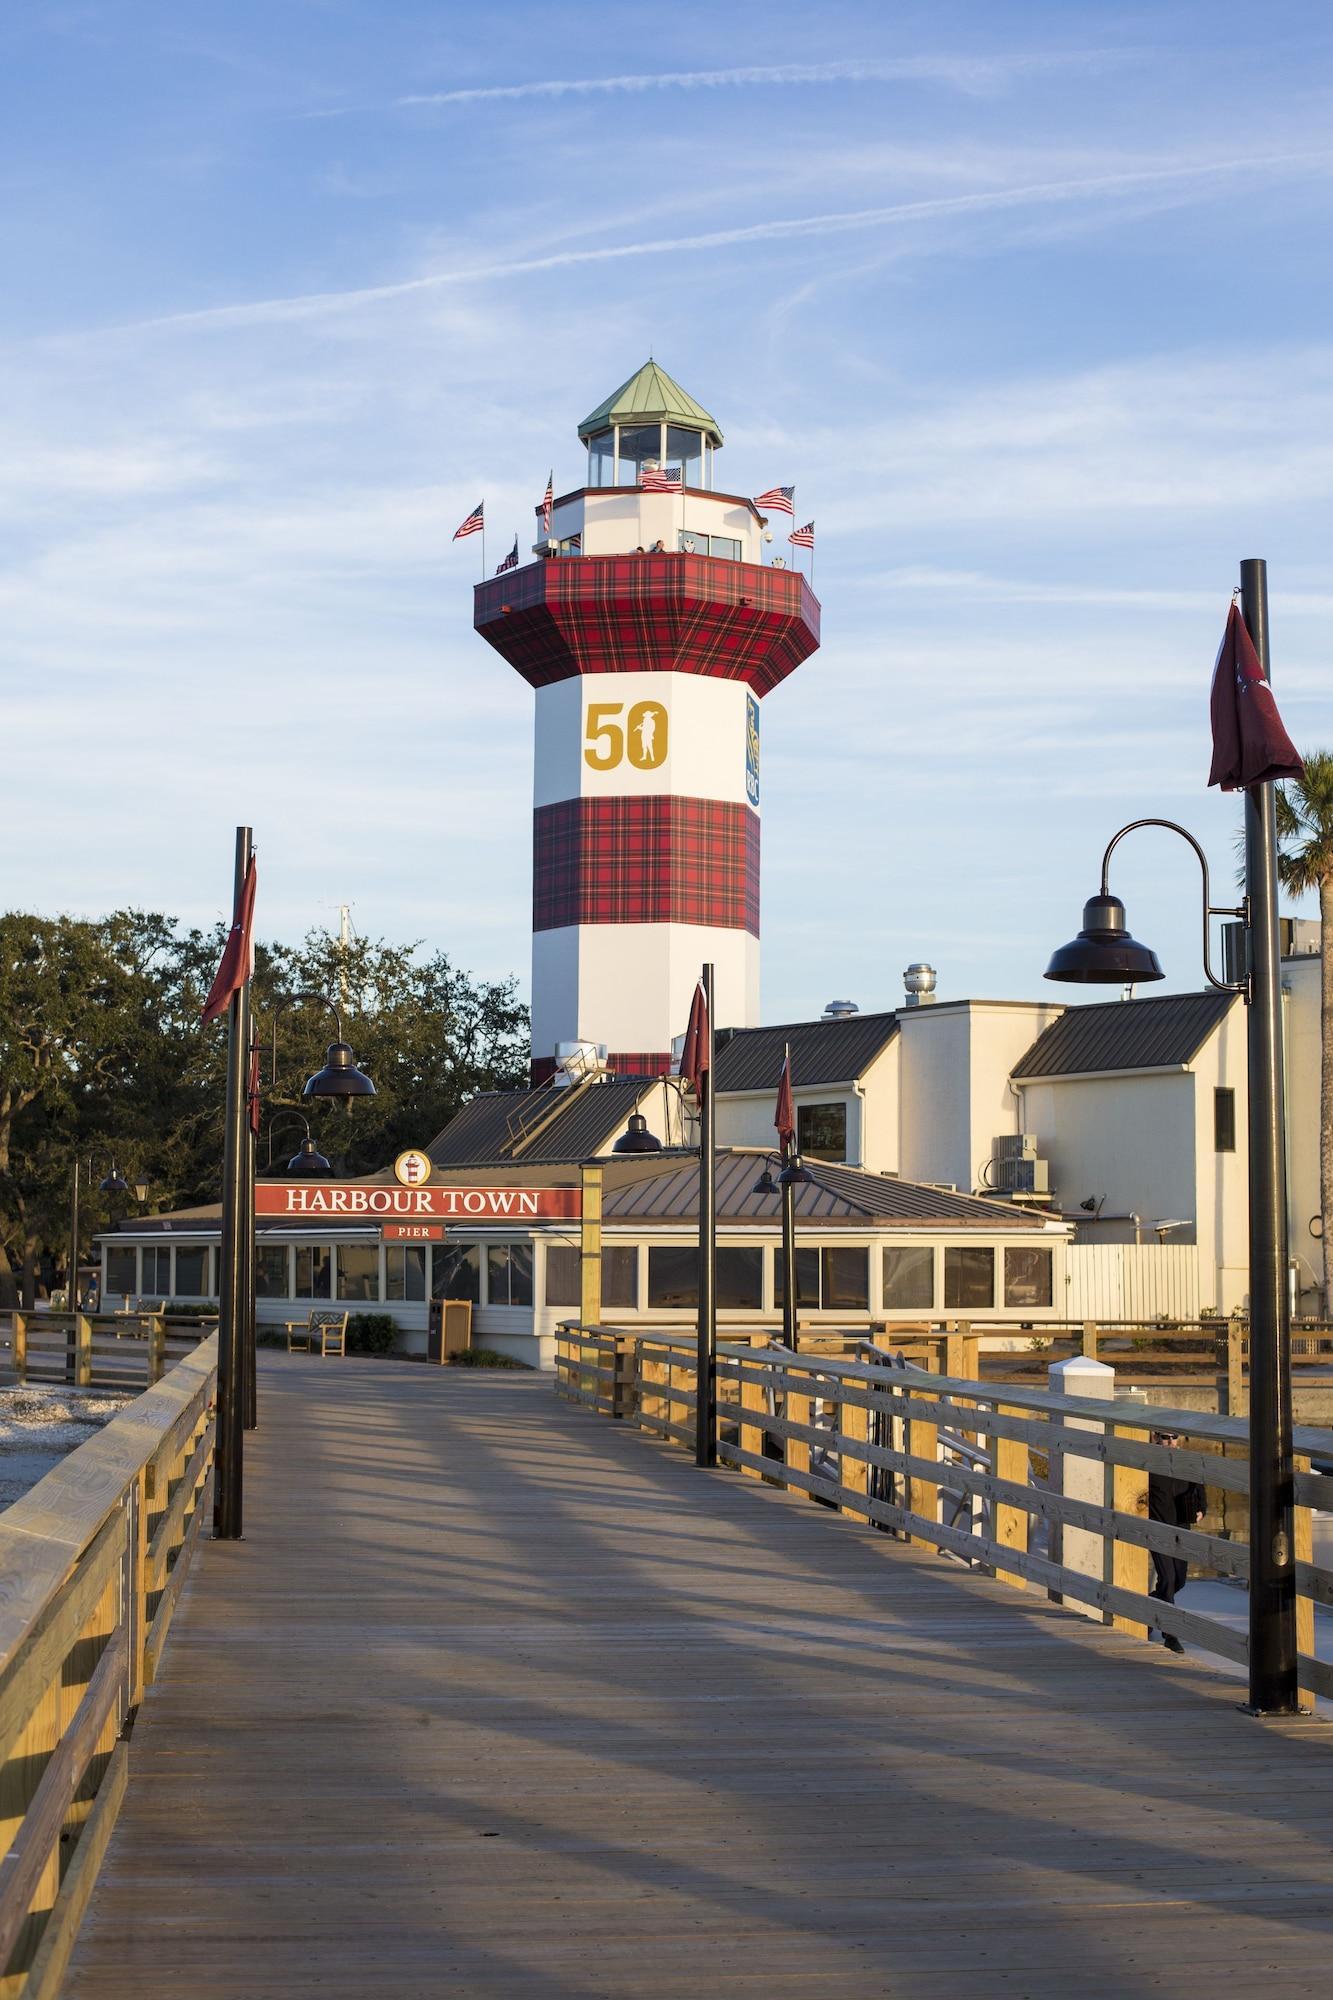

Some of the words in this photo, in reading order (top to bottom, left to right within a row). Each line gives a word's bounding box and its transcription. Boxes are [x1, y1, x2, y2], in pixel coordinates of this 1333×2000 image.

[584, 700, 668, 771] 50
[285, 1189, 435, 1213] HARBOUR
[442, 1191, 540, 1214] TOWN
[398, 1227, 430, 1238] PIER
